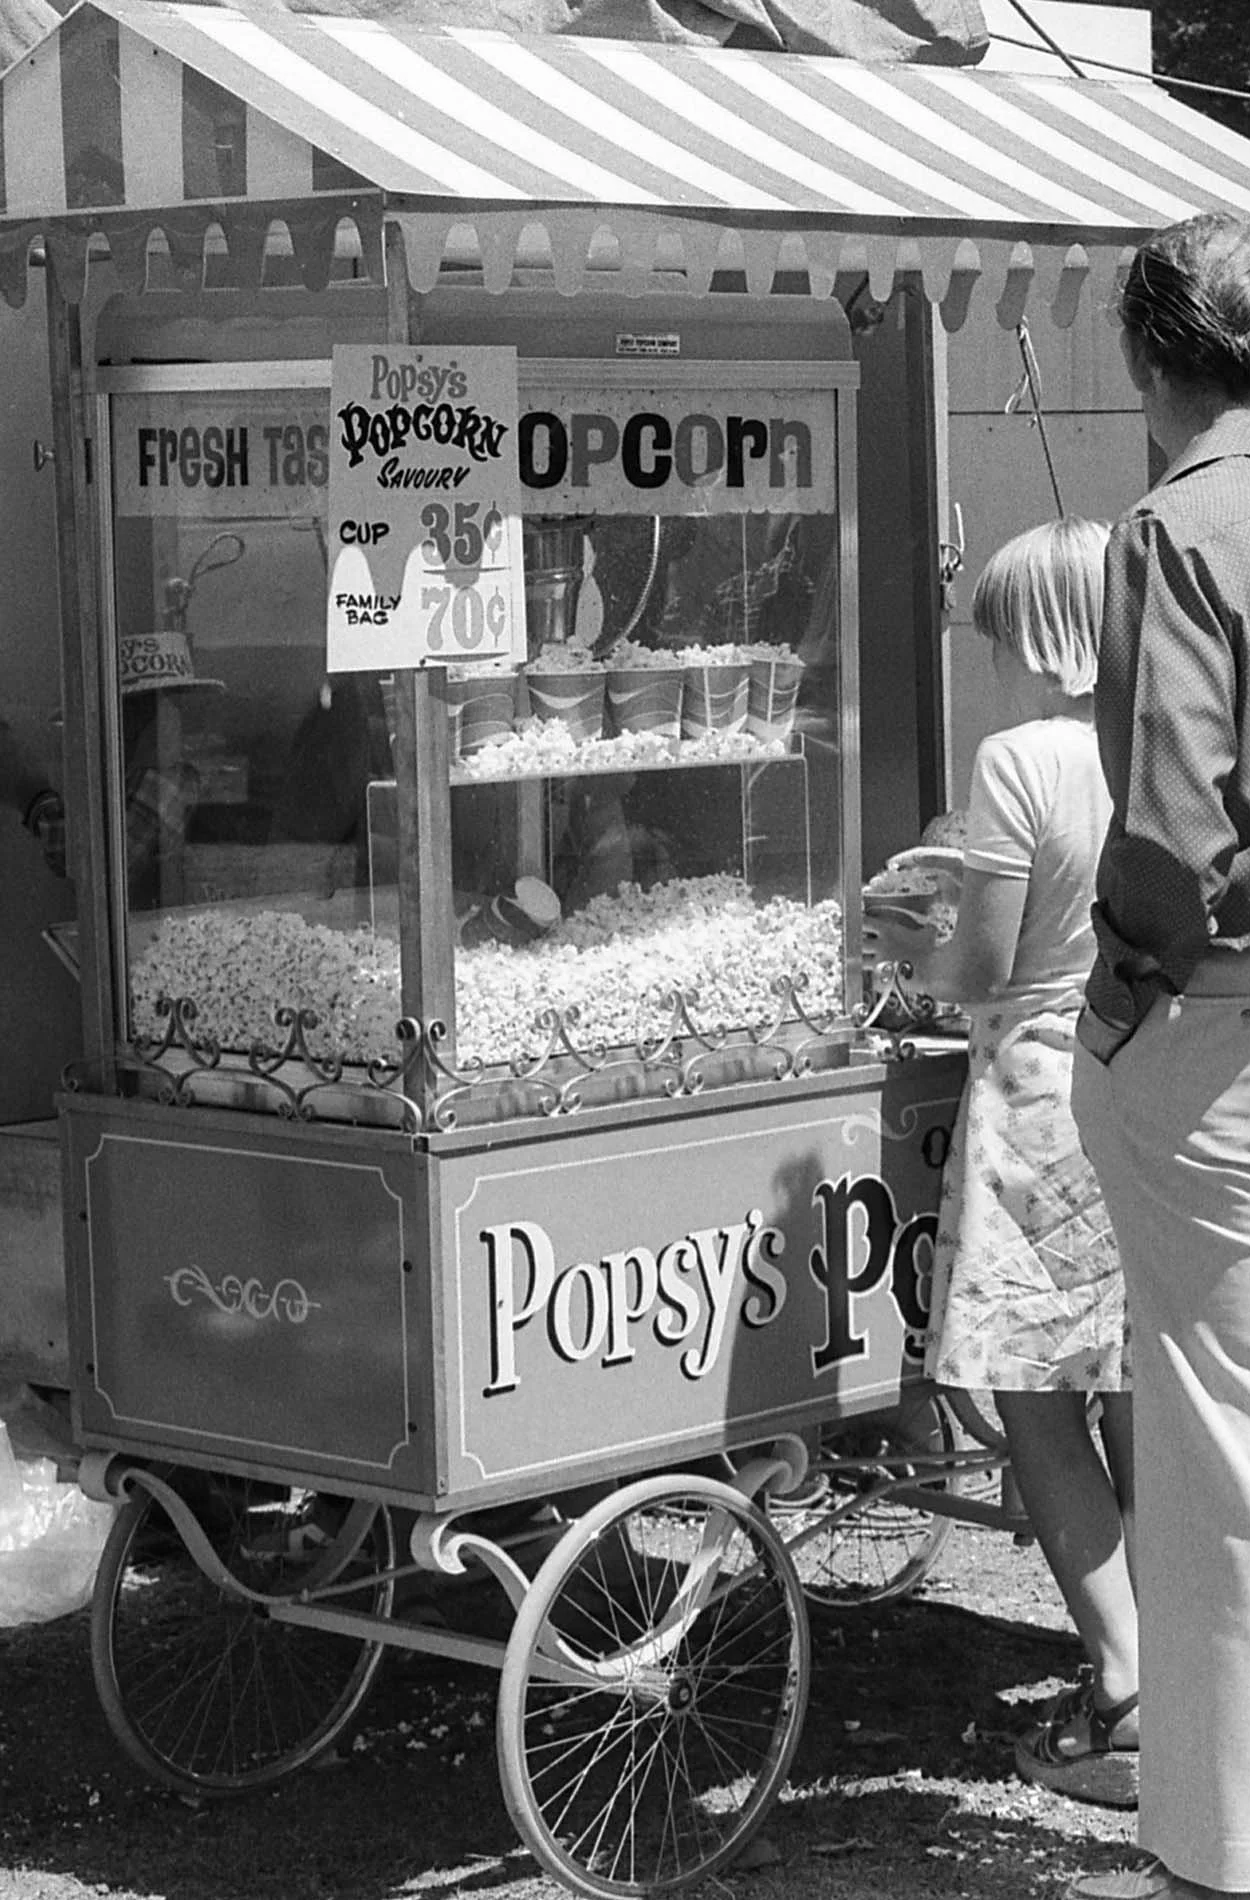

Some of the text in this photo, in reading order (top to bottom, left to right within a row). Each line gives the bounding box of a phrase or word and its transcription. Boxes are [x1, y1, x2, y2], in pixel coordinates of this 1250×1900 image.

[370, 354, 468, 405] Popsy's
[337, 402, 509, 469] POPCORN
[339, 500, 502, 566] CUP 35¢
[336, 593, 401, 611] FAMILY
[345, 610, 389, 626] BAG
[421, 586, 506, 651] 70¢
[479, 1208, 788, 1398] Popsy's
